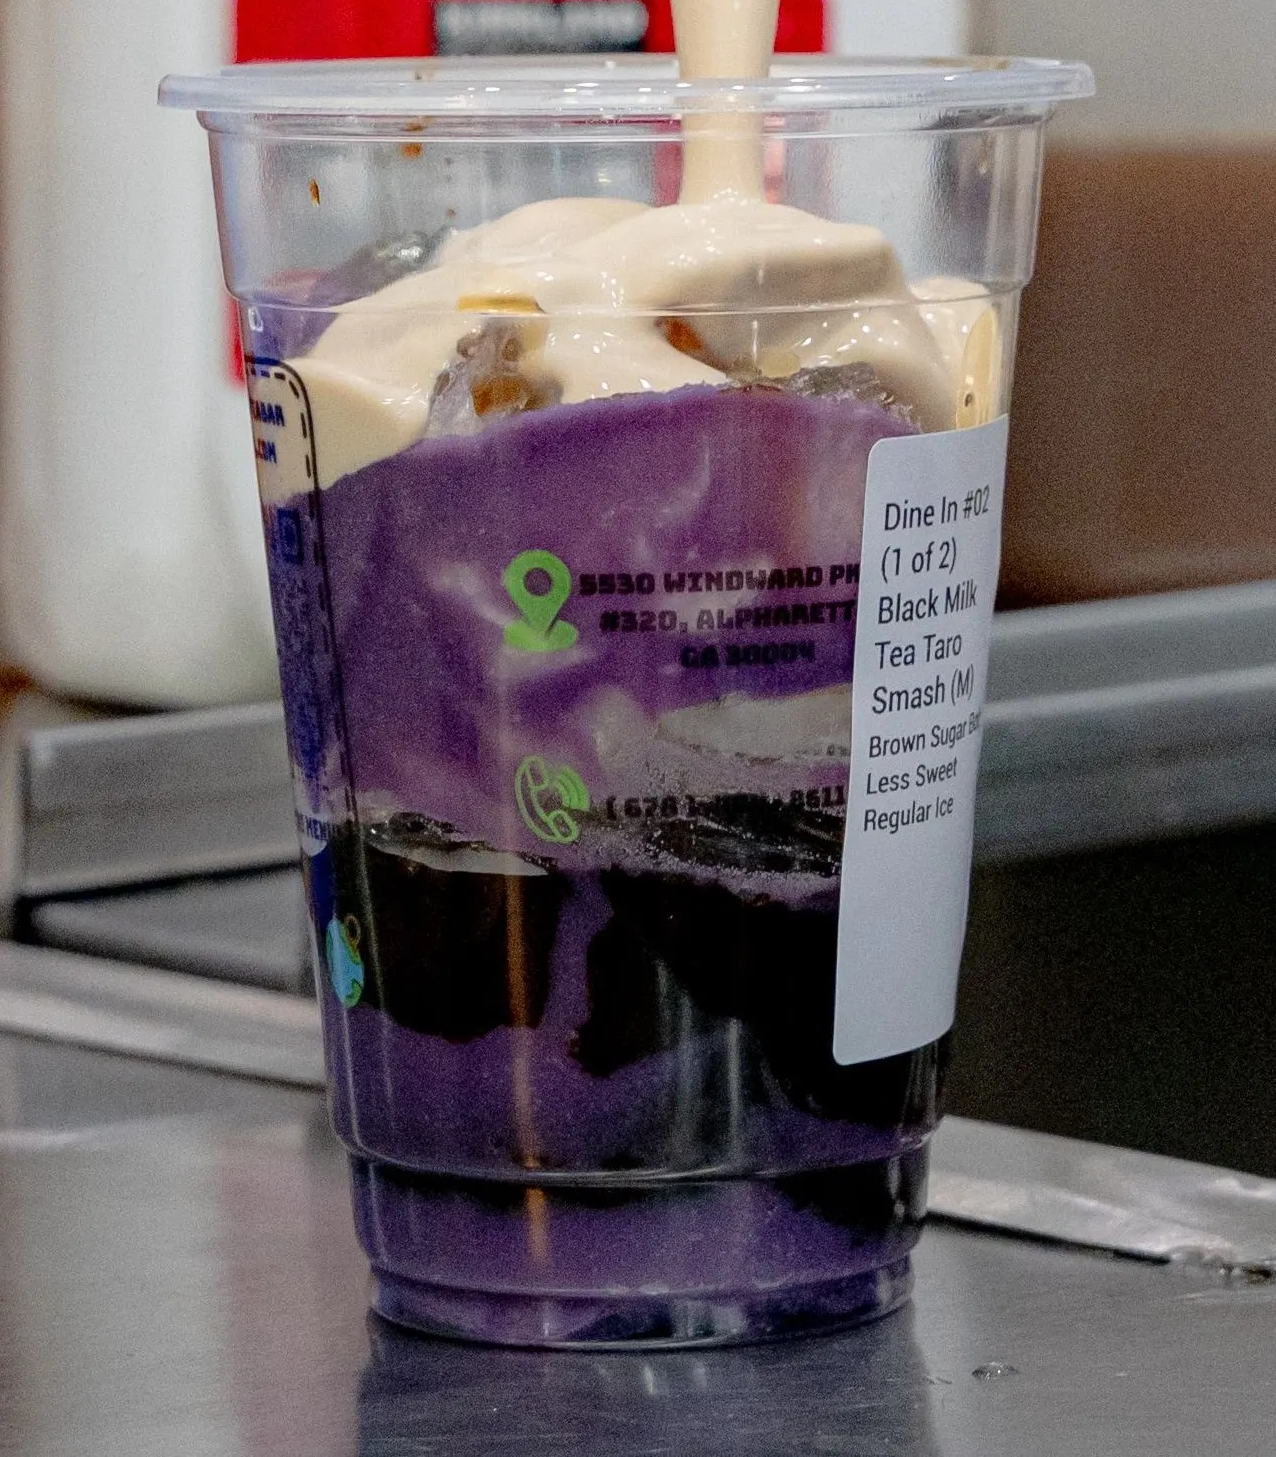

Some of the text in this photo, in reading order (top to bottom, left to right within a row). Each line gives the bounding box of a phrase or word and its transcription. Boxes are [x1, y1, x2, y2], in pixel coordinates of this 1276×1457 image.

[884, 484, 990, 531] Dine In #02
[663, 564, 823, 595] WINDWARD
[881, 537, 957, 584] (1 of 2)
[878, 579, 978, 625] Black Milk
[875, 634, 962, 670] Tea Taro
[872, 663, 974, 714] Smash (M)
[869, 732, 926, 758] Brown
[930, 720, 967, 749] Sugar
[866, 756, 958, 795] Less Sweet
[864, 797, 954, 834] Regular Ice
